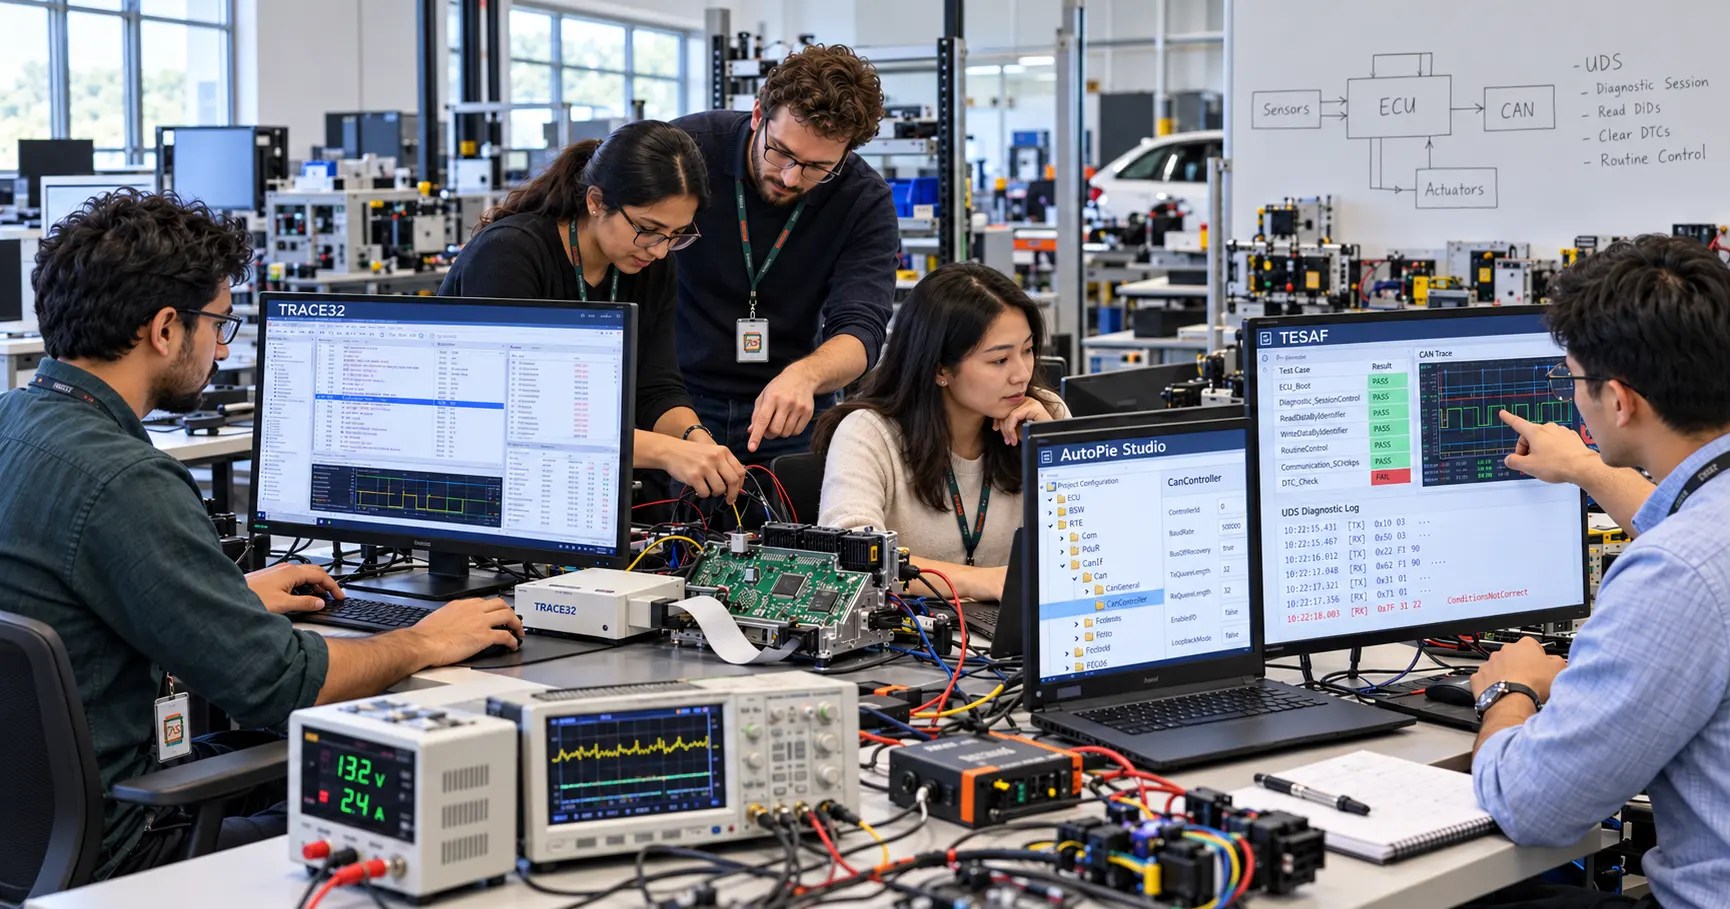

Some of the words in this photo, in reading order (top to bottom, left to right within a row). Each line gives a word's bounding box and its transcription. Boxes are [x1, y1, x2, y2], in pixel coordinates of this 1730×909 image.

[1585, 53, 1623, 73] UDS
[1596, 78, 1655, 96] Diagnostic
[1664, 76, 1709, 90] Session
[1263, 102, 1310, 116] Sensors
[1380, 97, 1416, 116] ECU
[1501, 101, 1535, 119] CAN
[1598, 103, 1627, 118] Read
[1598, 127, 1632, 143] Clear
[1640, 125, 1671, 140] DTCs
[1600, 152, 1649, 168] Routine
[1658, 143, 1706, 164] Control
[1424, 182, 1485, 197] Actuators
[278, 303, 346, 317] TRACE32
[1279, 329, 1329, 345] TESAF
[1419, 350, 1434, 359] CAN
[1279, 367, 1293, 375] Test
[1372, 362, 1392, 370] Result
[1372, 377, 1389, 385] PASS
[1279, 382, 1311, 392] ECU_Boot
[1373, 393, 1390, 401] PASS
[1373, 409, 1390, 417] PASS
[1060, 444, 1118, 462] AutoPie
[1122, 439, 1166, 456] Studio
[1280, 444, 1328, 454] RoutineControl
[1374, 441, 1391, 449] PASS
[1375, 457, 1392, 465] PASS
[1167, 474, 1222, 487] CanController
[1376, 473, 1390, 481] FAIL
[1282, 478, 1319, 488] DTC_Check
[1067, 494, 1081, 502] ECU
[1069, 506, 1085, 515] BSW
[1281, 506, 1300, 517] UDS
[1301, 504, 1343, 517] Diagnostic
[1345, 503, 1360, 515] Log
[1069, 519, 1083, 527] RTE
[1348, 520, 1365, 531] [TX]
[1081, 532, 1098, 540] Com
[1349, 534, 1366, 545] [RX]
[1349, 549, 1366, 560] [TX]
[1349, 563, 1367, 574] [RX]
[1094, 572, 1107, 581] Can
[1350, 577, 1367, 589] [TX]
[1350, 591, 1368, 603] [RX]
[534, 601, 577, 616] TRACE32
[373, 806, 385, 822] A
